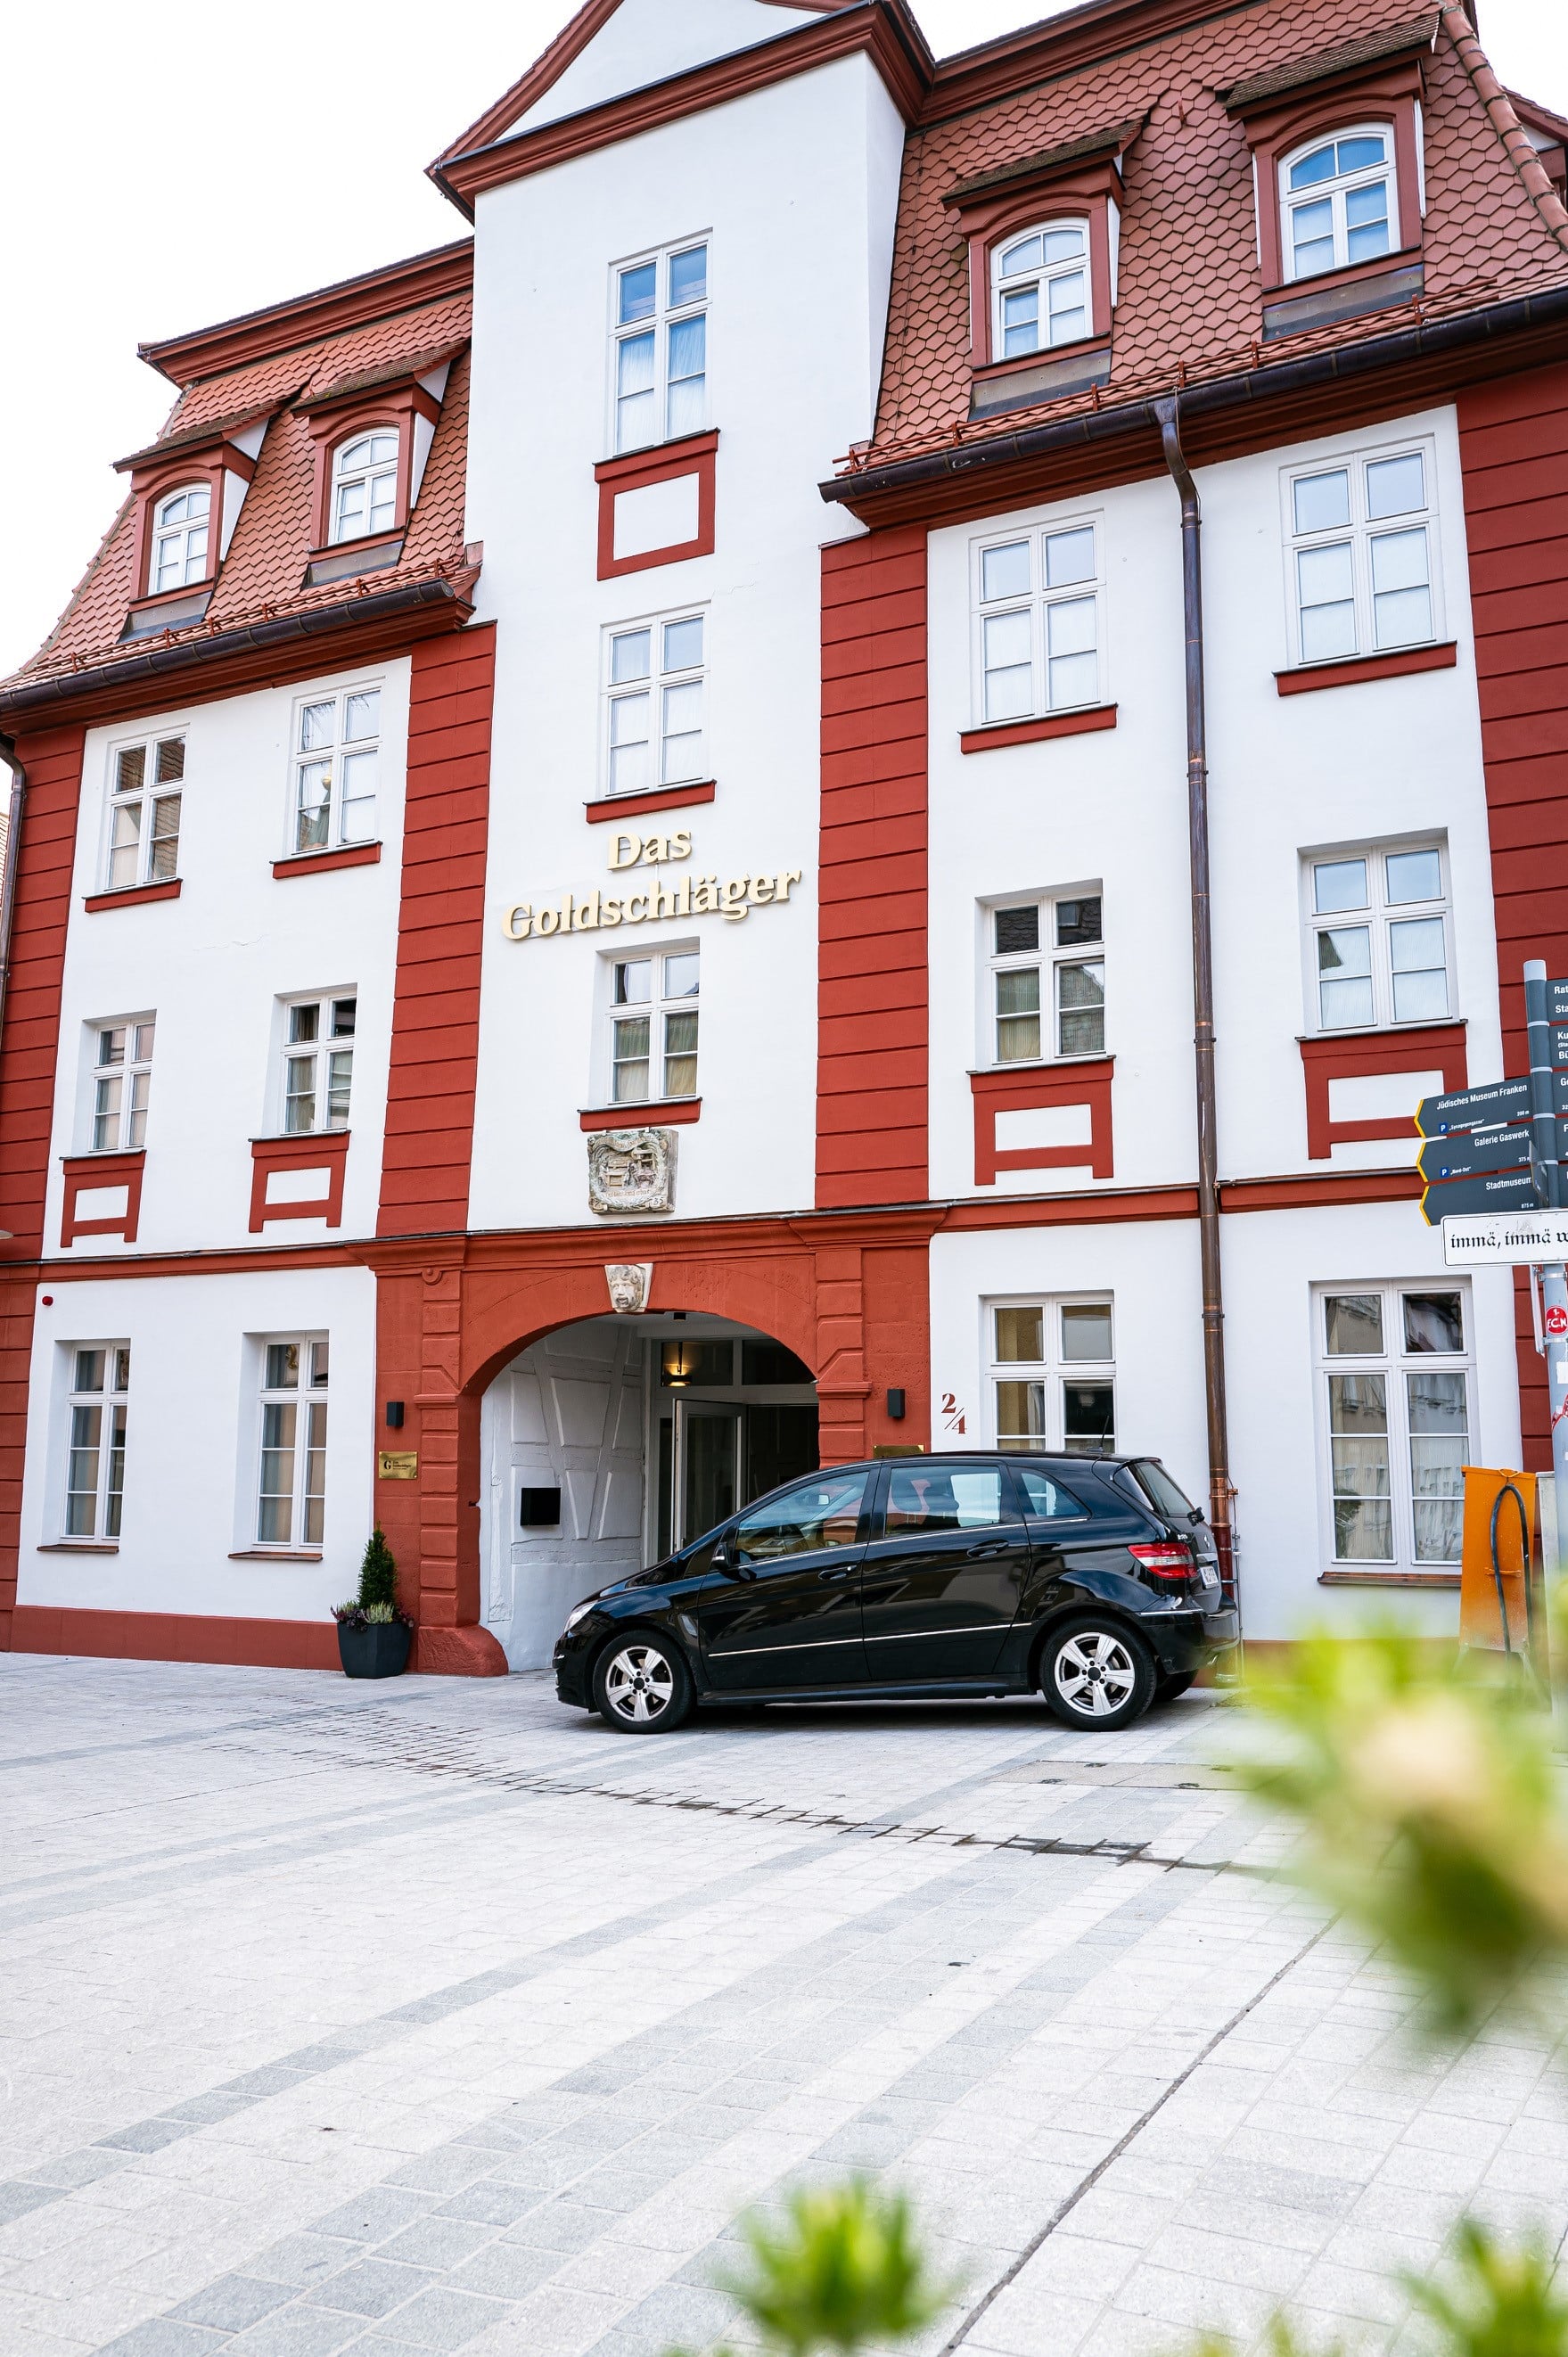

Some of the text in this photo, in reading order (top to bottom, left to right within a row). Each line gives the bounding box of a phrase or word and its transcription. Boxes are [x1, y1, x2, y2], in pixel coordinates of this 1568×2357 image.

[606, 830, 693, 871] Das
[502, 869, 802, 941] Goldschläger
[1436, 1084, 1528, 1111] Jüdisches Museum Franken
[1474, 1129, 1530, 1147] Galerie Gaswerk
[1485, 1177, 1532, 1191] Stadtmuseum
[1505, 1228, 1551, 1246] immä
[383, 1459, 391, 1470] G
